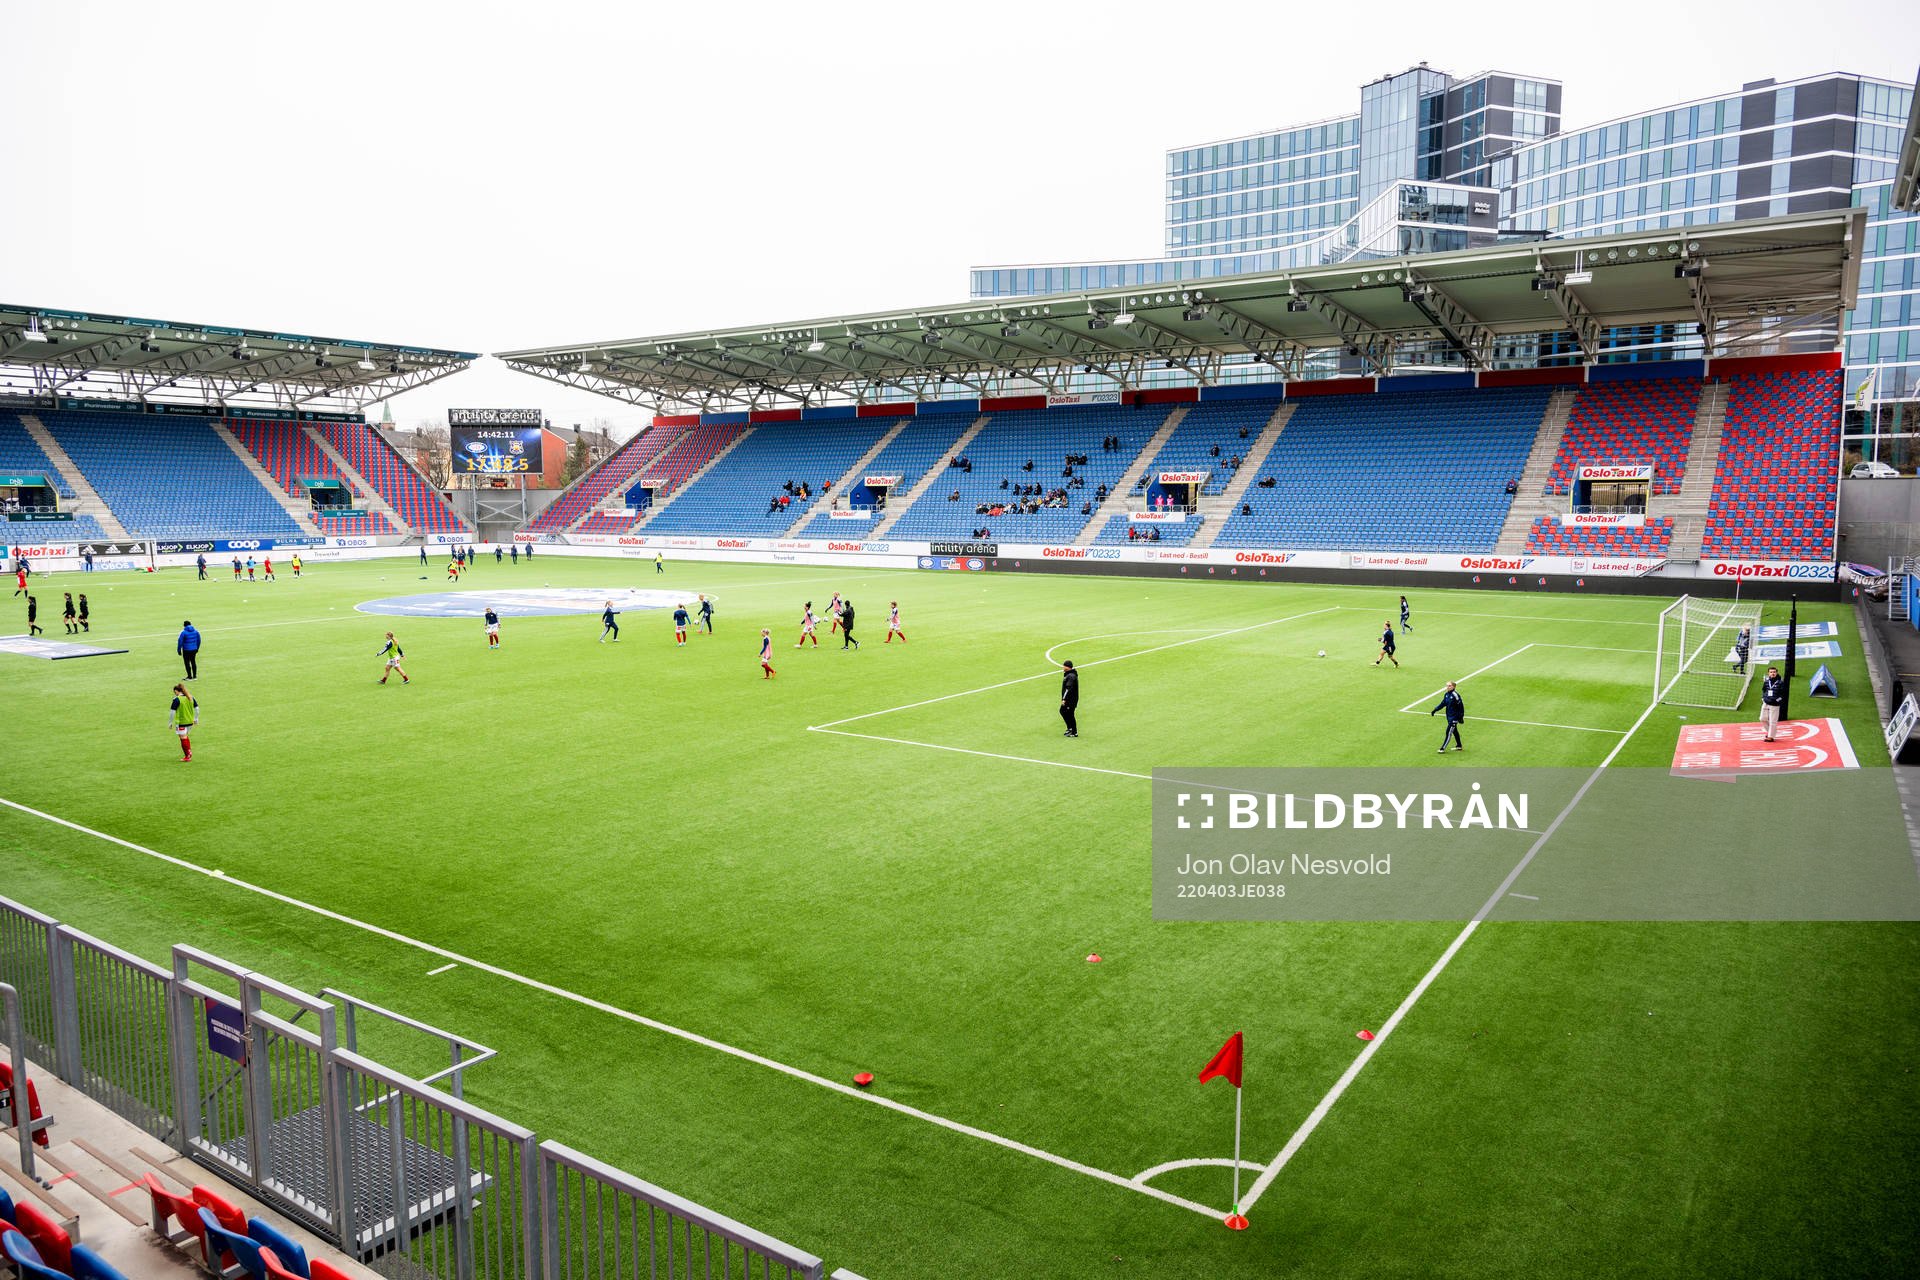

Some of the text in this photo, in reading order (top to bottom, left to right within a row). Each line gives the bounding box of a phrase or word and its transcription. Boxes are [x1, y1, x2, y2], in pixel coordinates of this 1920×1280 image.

[1049, 395, 1081, 405] OsloTaxi
[454, 409, 535, 422] intility arena
[477, 431, 515, 439] 14:42:11
[1161, 473, 1199, 482] OsloTaxi
[1583, 467, 1637, 478] OsloTaxi
[866, 477, 894, 485] OsloTaxi
[1575, 515, 1617, 523] OsloTaxi
[228, 540, 260, 550] coop
[618, 537, 644, 545] OsloTaxi
[717, 539, 746, 548] OsloTaxi
[12, 547, 66, 557] OsloTaxi
[828, 542, 890, 553] OsloTaxi 02323
[931, 542, 996, 556] intility arena
[1043, 547, 1121, 559] OsloTaxi 02323
[1235, 552, 1286, 563] OsloTaxi
[1384, 557, 1399, 565] ned
[1404, 557, 1428, 565] Bestill
[1460, 557, 1522, 570] OsloTaxi
[1592, 562, 1610, 570] Last
[1611, 563, 1630, 571] ned
[1713, 563, 1836, 578] OsloTaxi 02323
